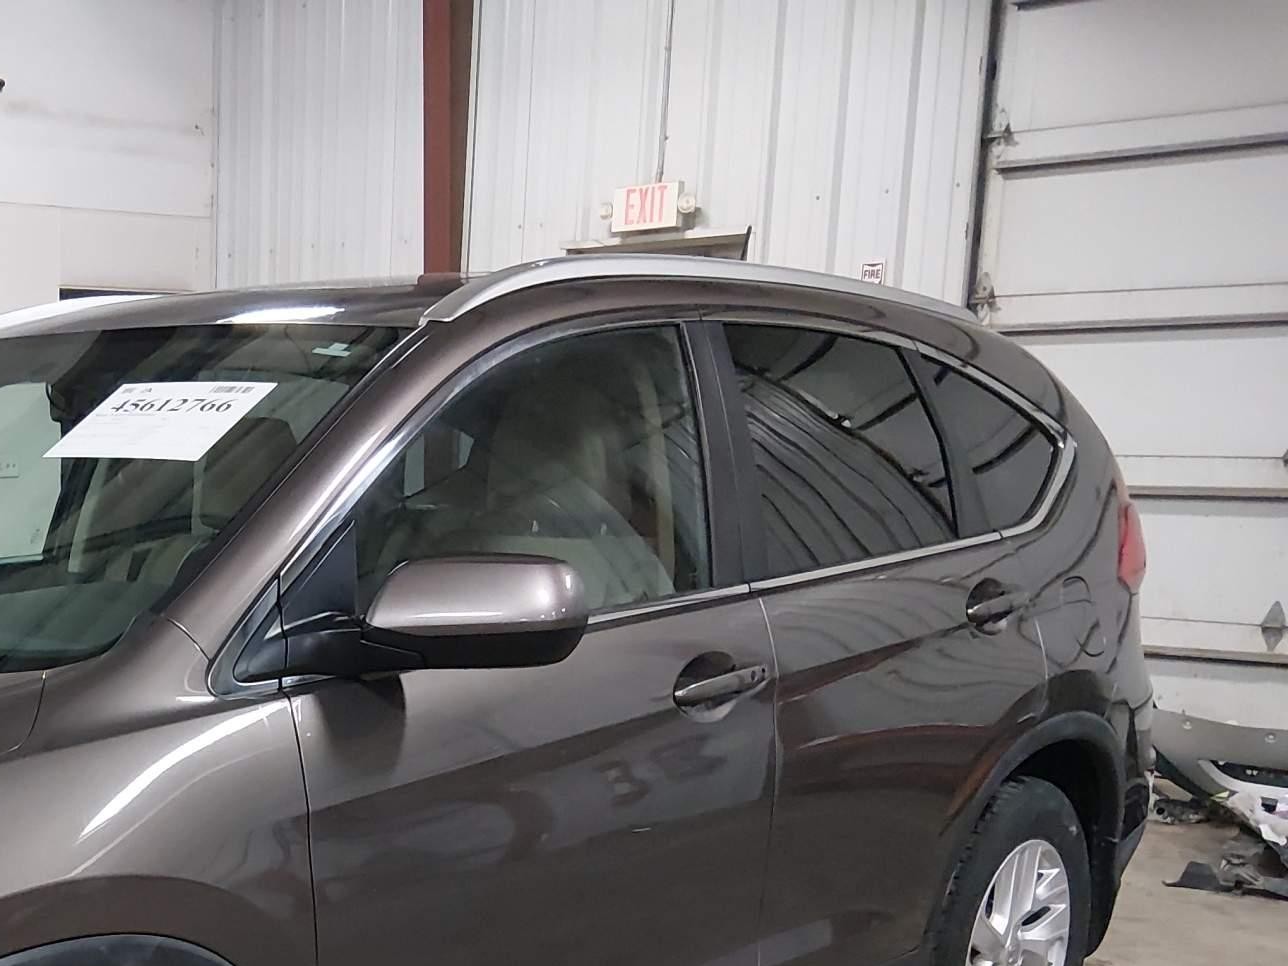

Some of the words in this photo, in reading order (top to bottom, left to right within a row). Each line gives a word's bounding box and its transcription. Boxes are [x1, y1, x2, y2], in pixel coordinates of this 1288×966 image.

[624, 185, 668, 225] EXIT
[864, 269, 881, 279] FIRE
[111, 398, 237, 413] 45612766
